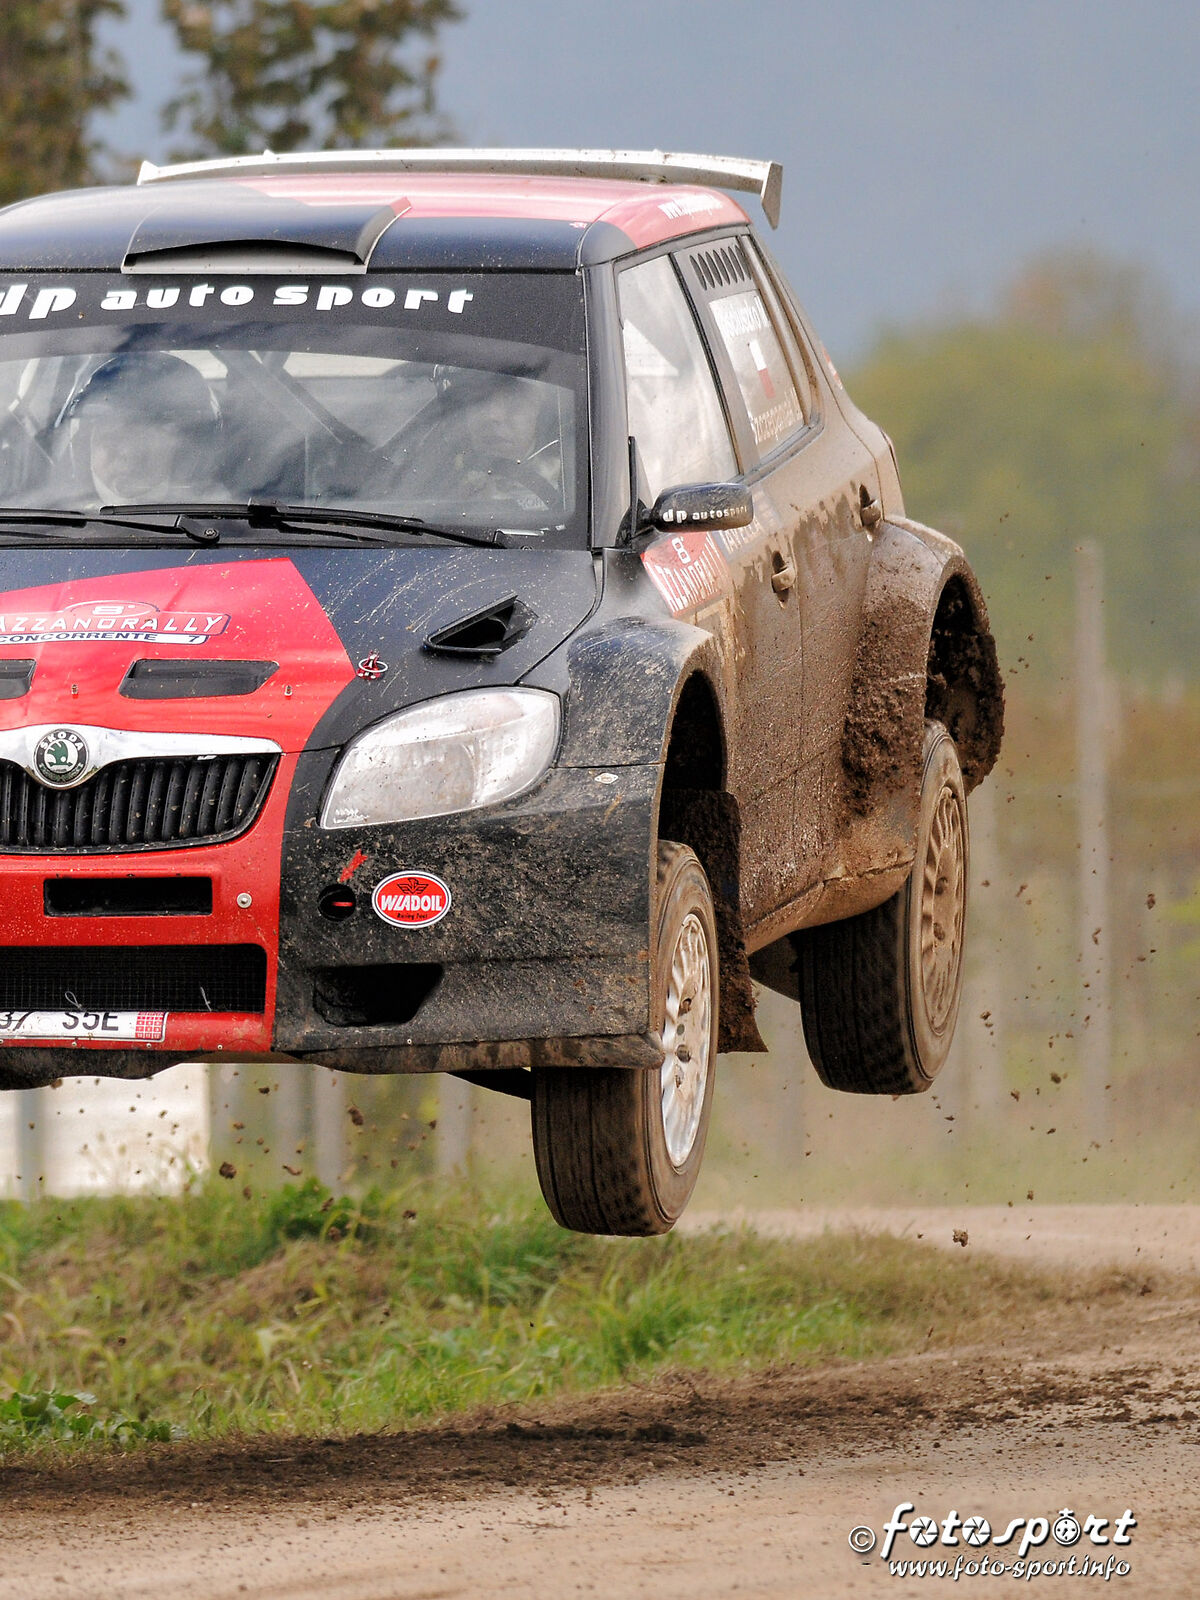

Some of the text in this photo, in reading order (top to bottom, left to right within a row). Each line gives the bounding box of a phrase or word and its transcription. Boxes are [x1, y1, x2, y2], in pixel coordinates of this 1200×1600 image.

[100, 284, 254, 311] auto
[273, 285, 474, 314] sport
[662, 509, 688, 523] dp
[188, 634, 201, 643] 7
